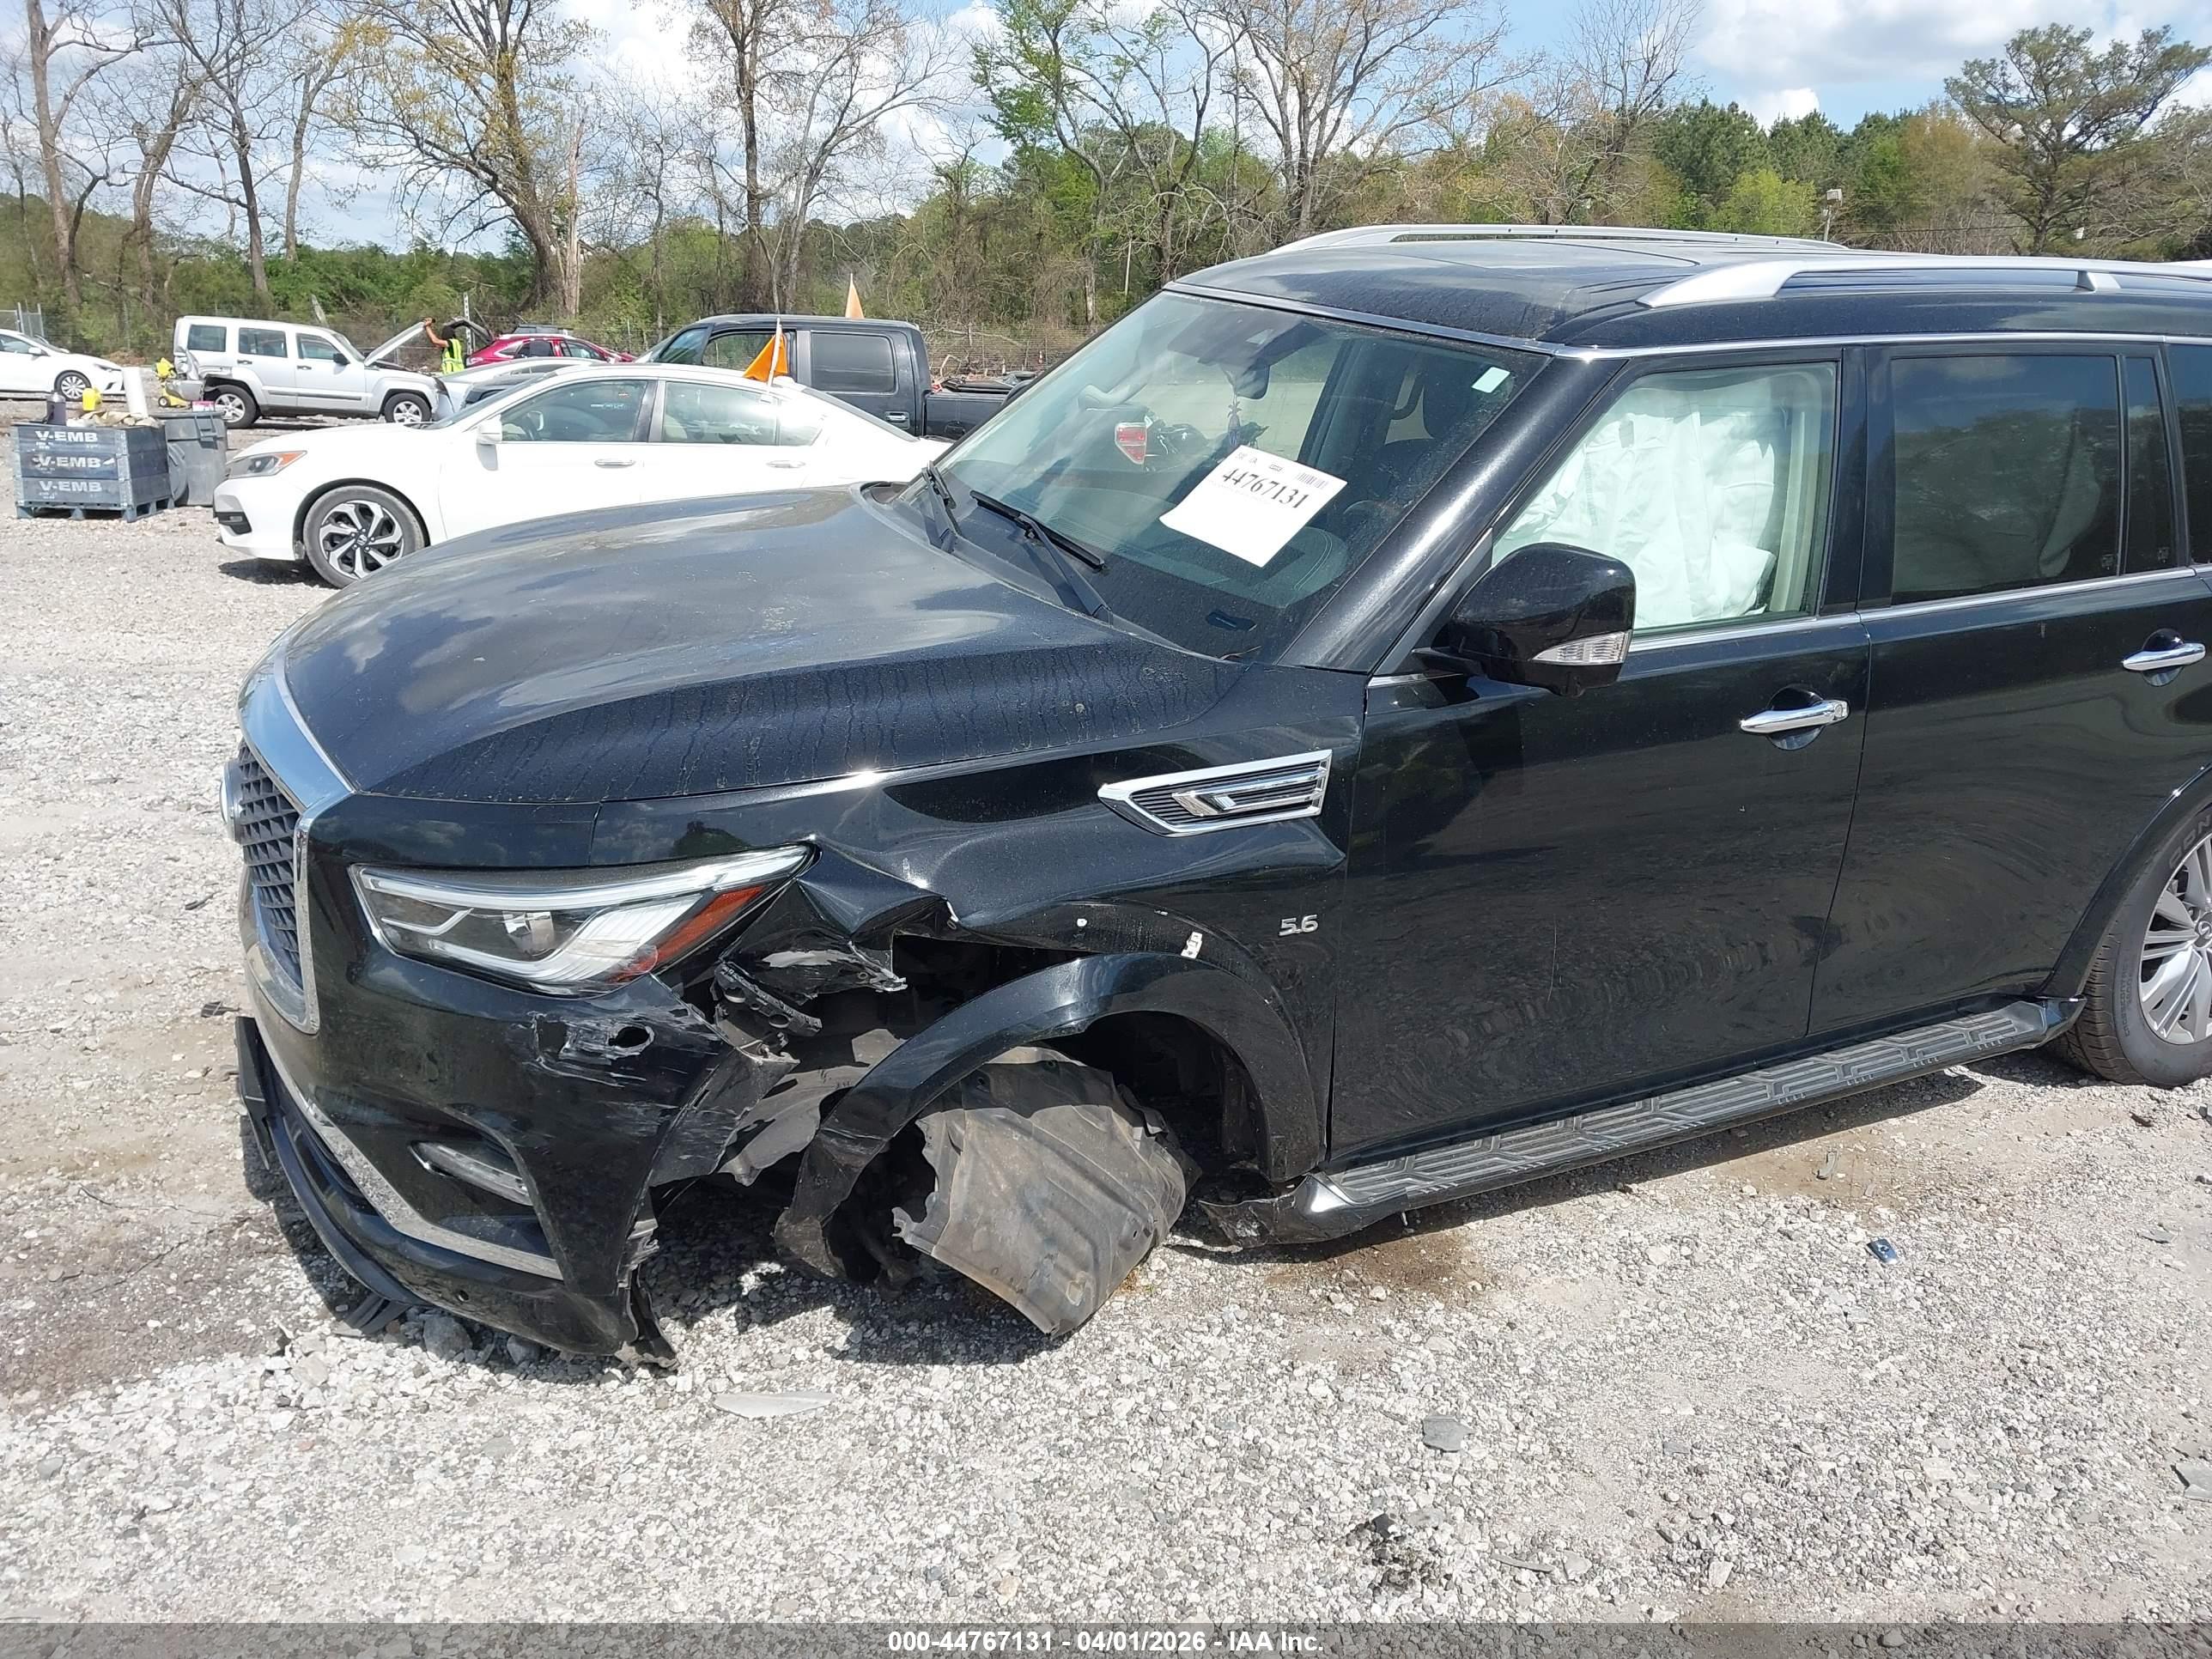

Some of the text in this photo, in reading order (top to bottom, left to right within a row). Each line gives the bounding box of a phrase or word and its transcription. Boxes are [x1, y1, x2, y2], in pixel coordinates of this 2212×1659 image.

[34, 430, 99, 442] V-EMB
[38, 456, 101, 468] V-EMB
[39, 480, 103, 492] V-EMB
[1222, 467, 1310, 509] 44767131
